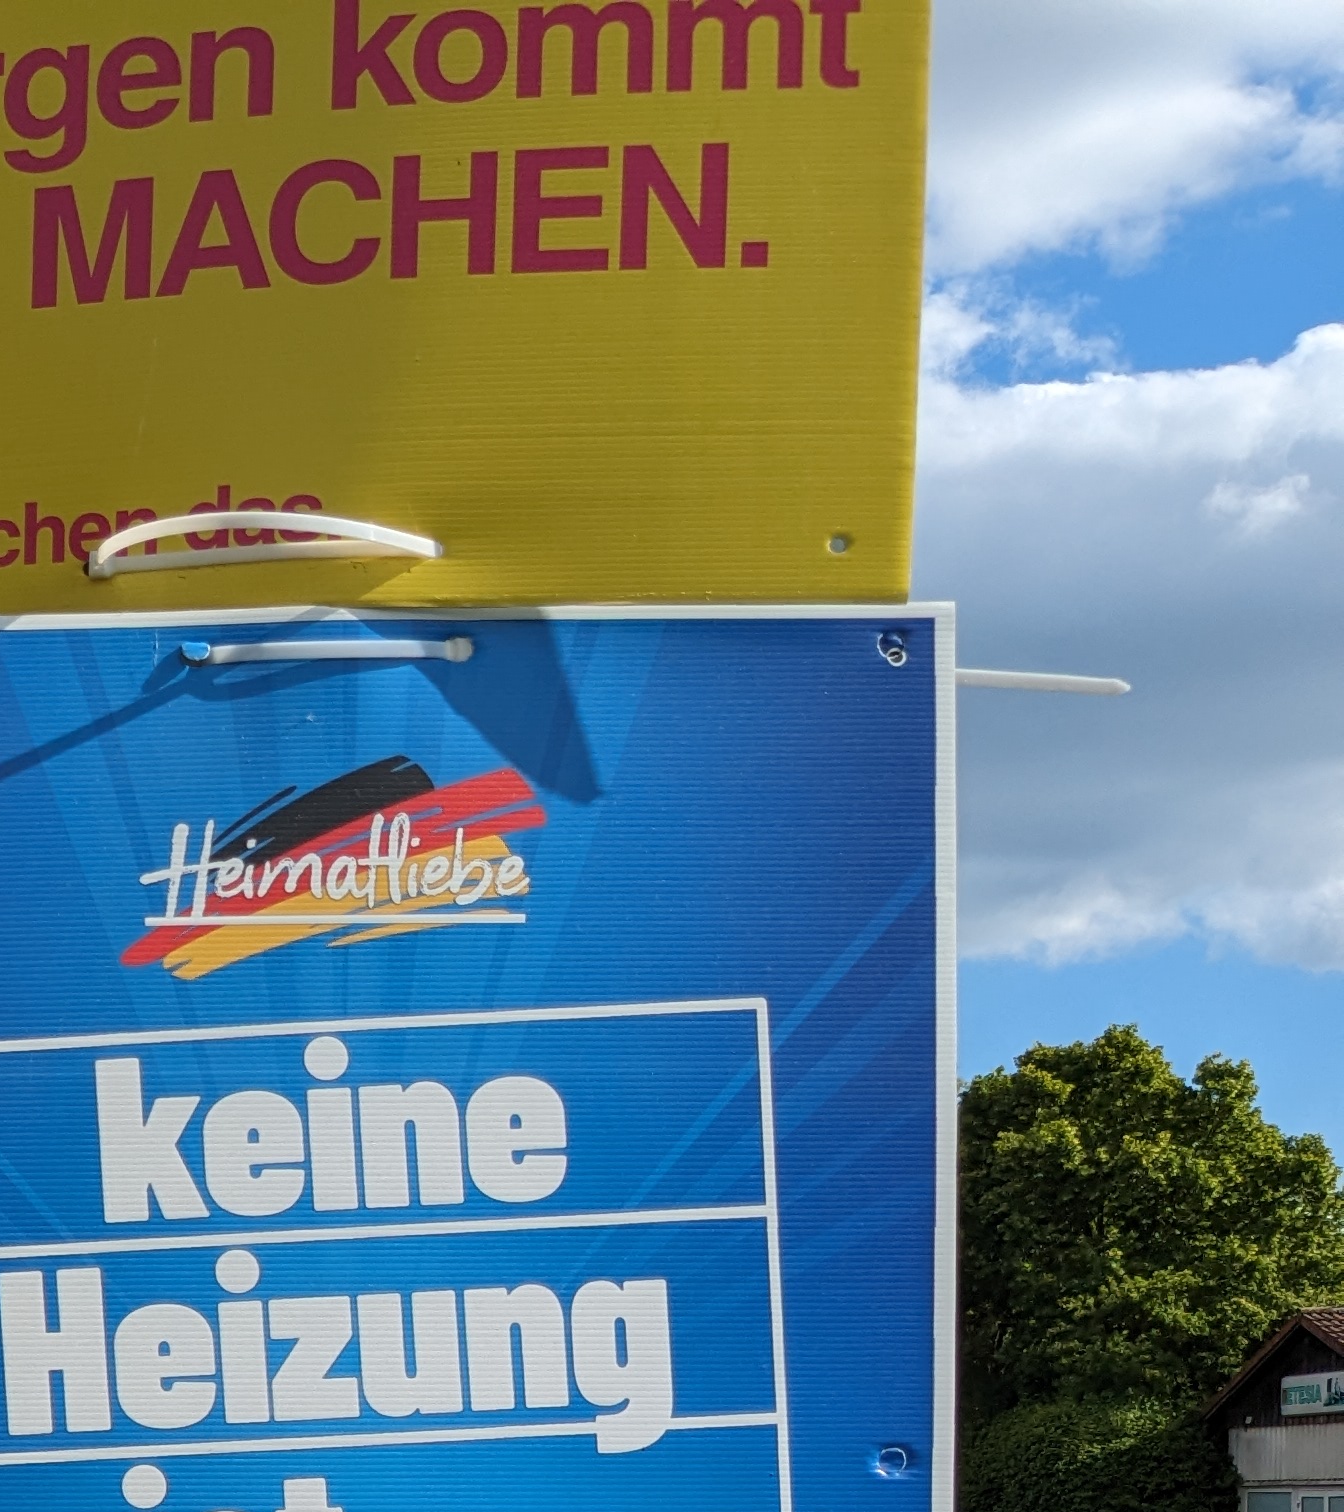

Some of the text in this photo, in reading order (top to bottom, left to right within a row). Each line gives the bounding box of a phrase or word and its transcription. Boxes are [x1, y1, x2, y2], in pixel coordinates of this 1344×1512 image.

[330, 0, 861, 112] kommt
[31, 142, 769, 312] MACHEN.
[139, 812, 529, 919] Heimatliebe
[95, 1035, 568, 1224] keine
